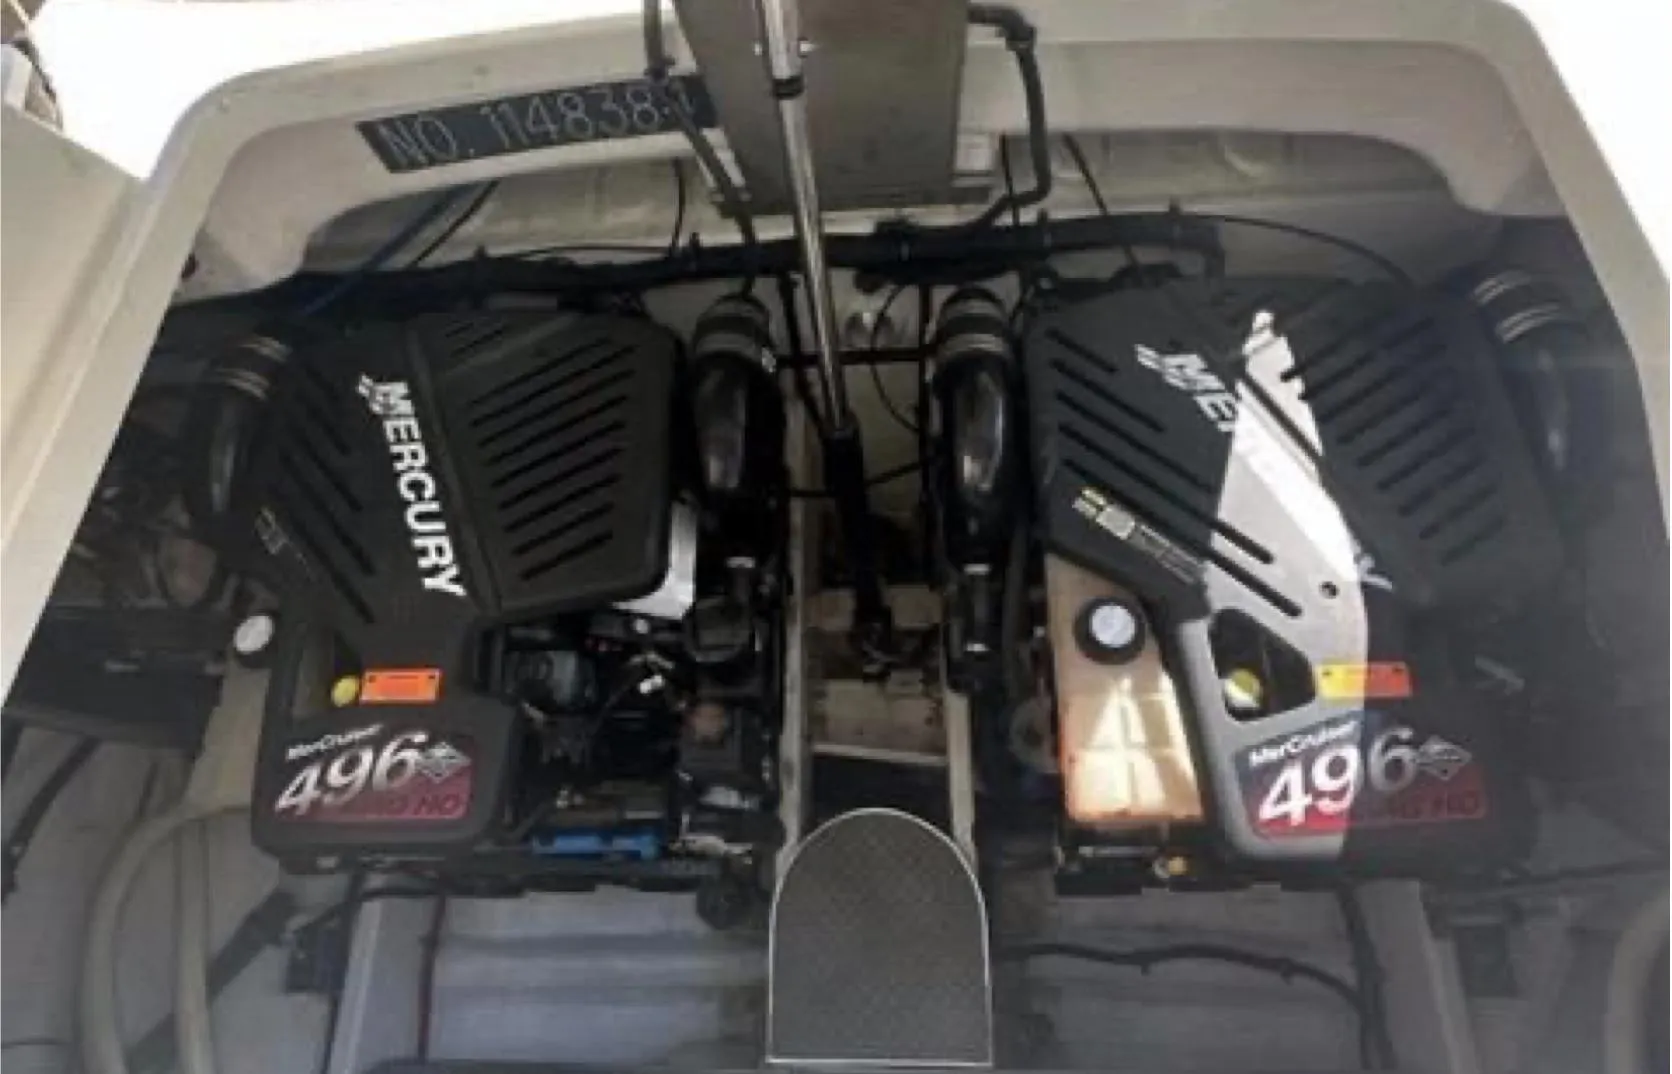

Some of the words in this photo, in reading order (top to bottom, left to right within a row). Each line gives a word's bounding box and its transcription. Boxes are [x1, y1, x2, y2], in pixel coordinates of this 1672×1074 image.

[376, 111, 475, 167] NO.
[359, 373, 466, 596] MERCURY
[274, 730, 430, 816] 496
[1258, 727, 1418, 827] 496
